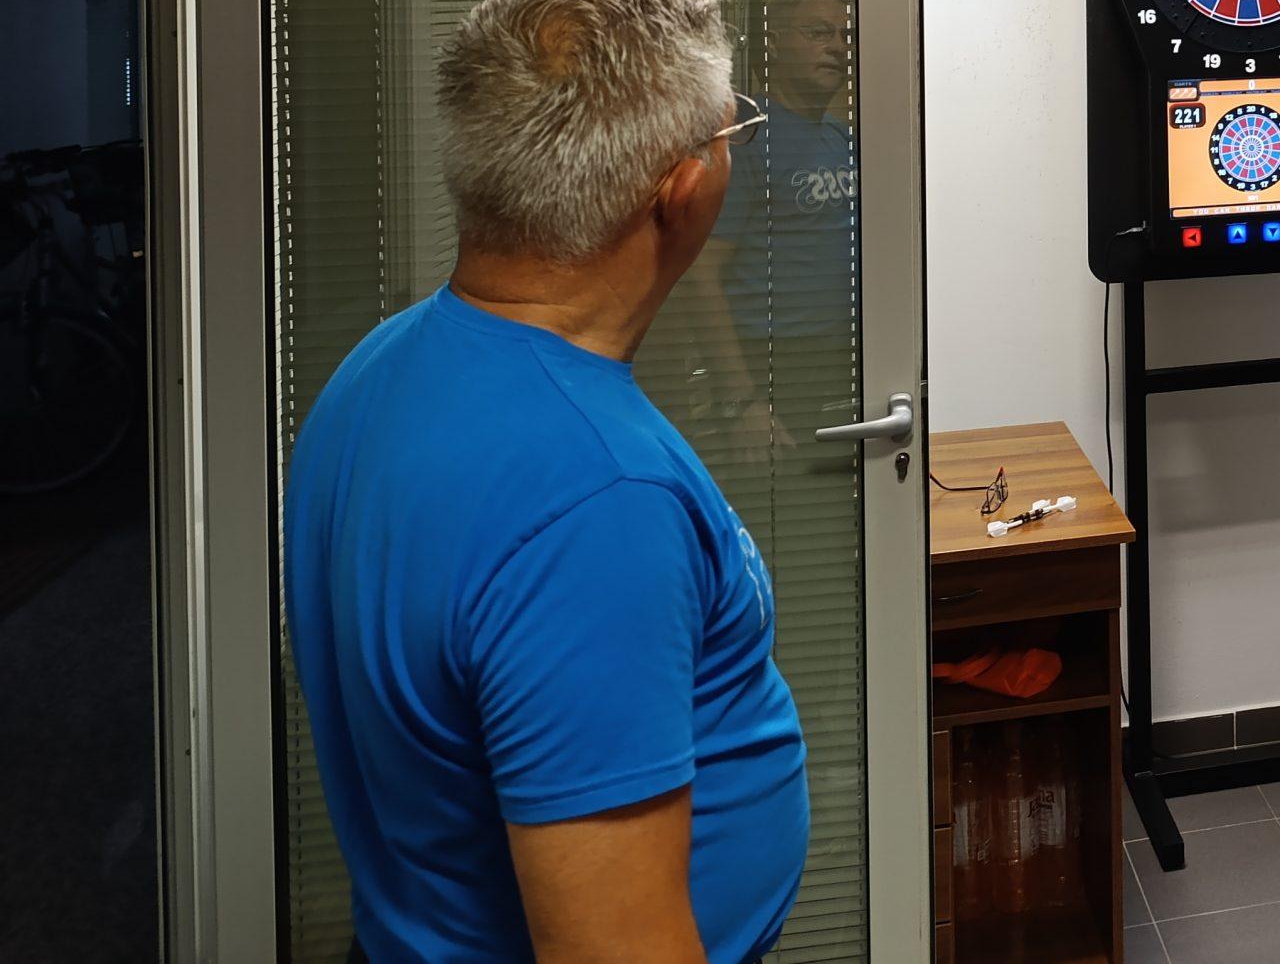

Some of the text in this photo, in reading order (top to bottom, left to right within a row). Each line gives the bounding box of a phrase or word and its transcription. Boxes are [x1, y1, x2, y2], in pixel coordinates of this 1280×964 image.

[1138, 10, 1157, 23] 16
[1171, 39, 1181, 53] 7
[1203, 54, 1221, 68] 19
[1245, 58, 1256, 72] 3
[1174, 107, 1200, 124] 221
